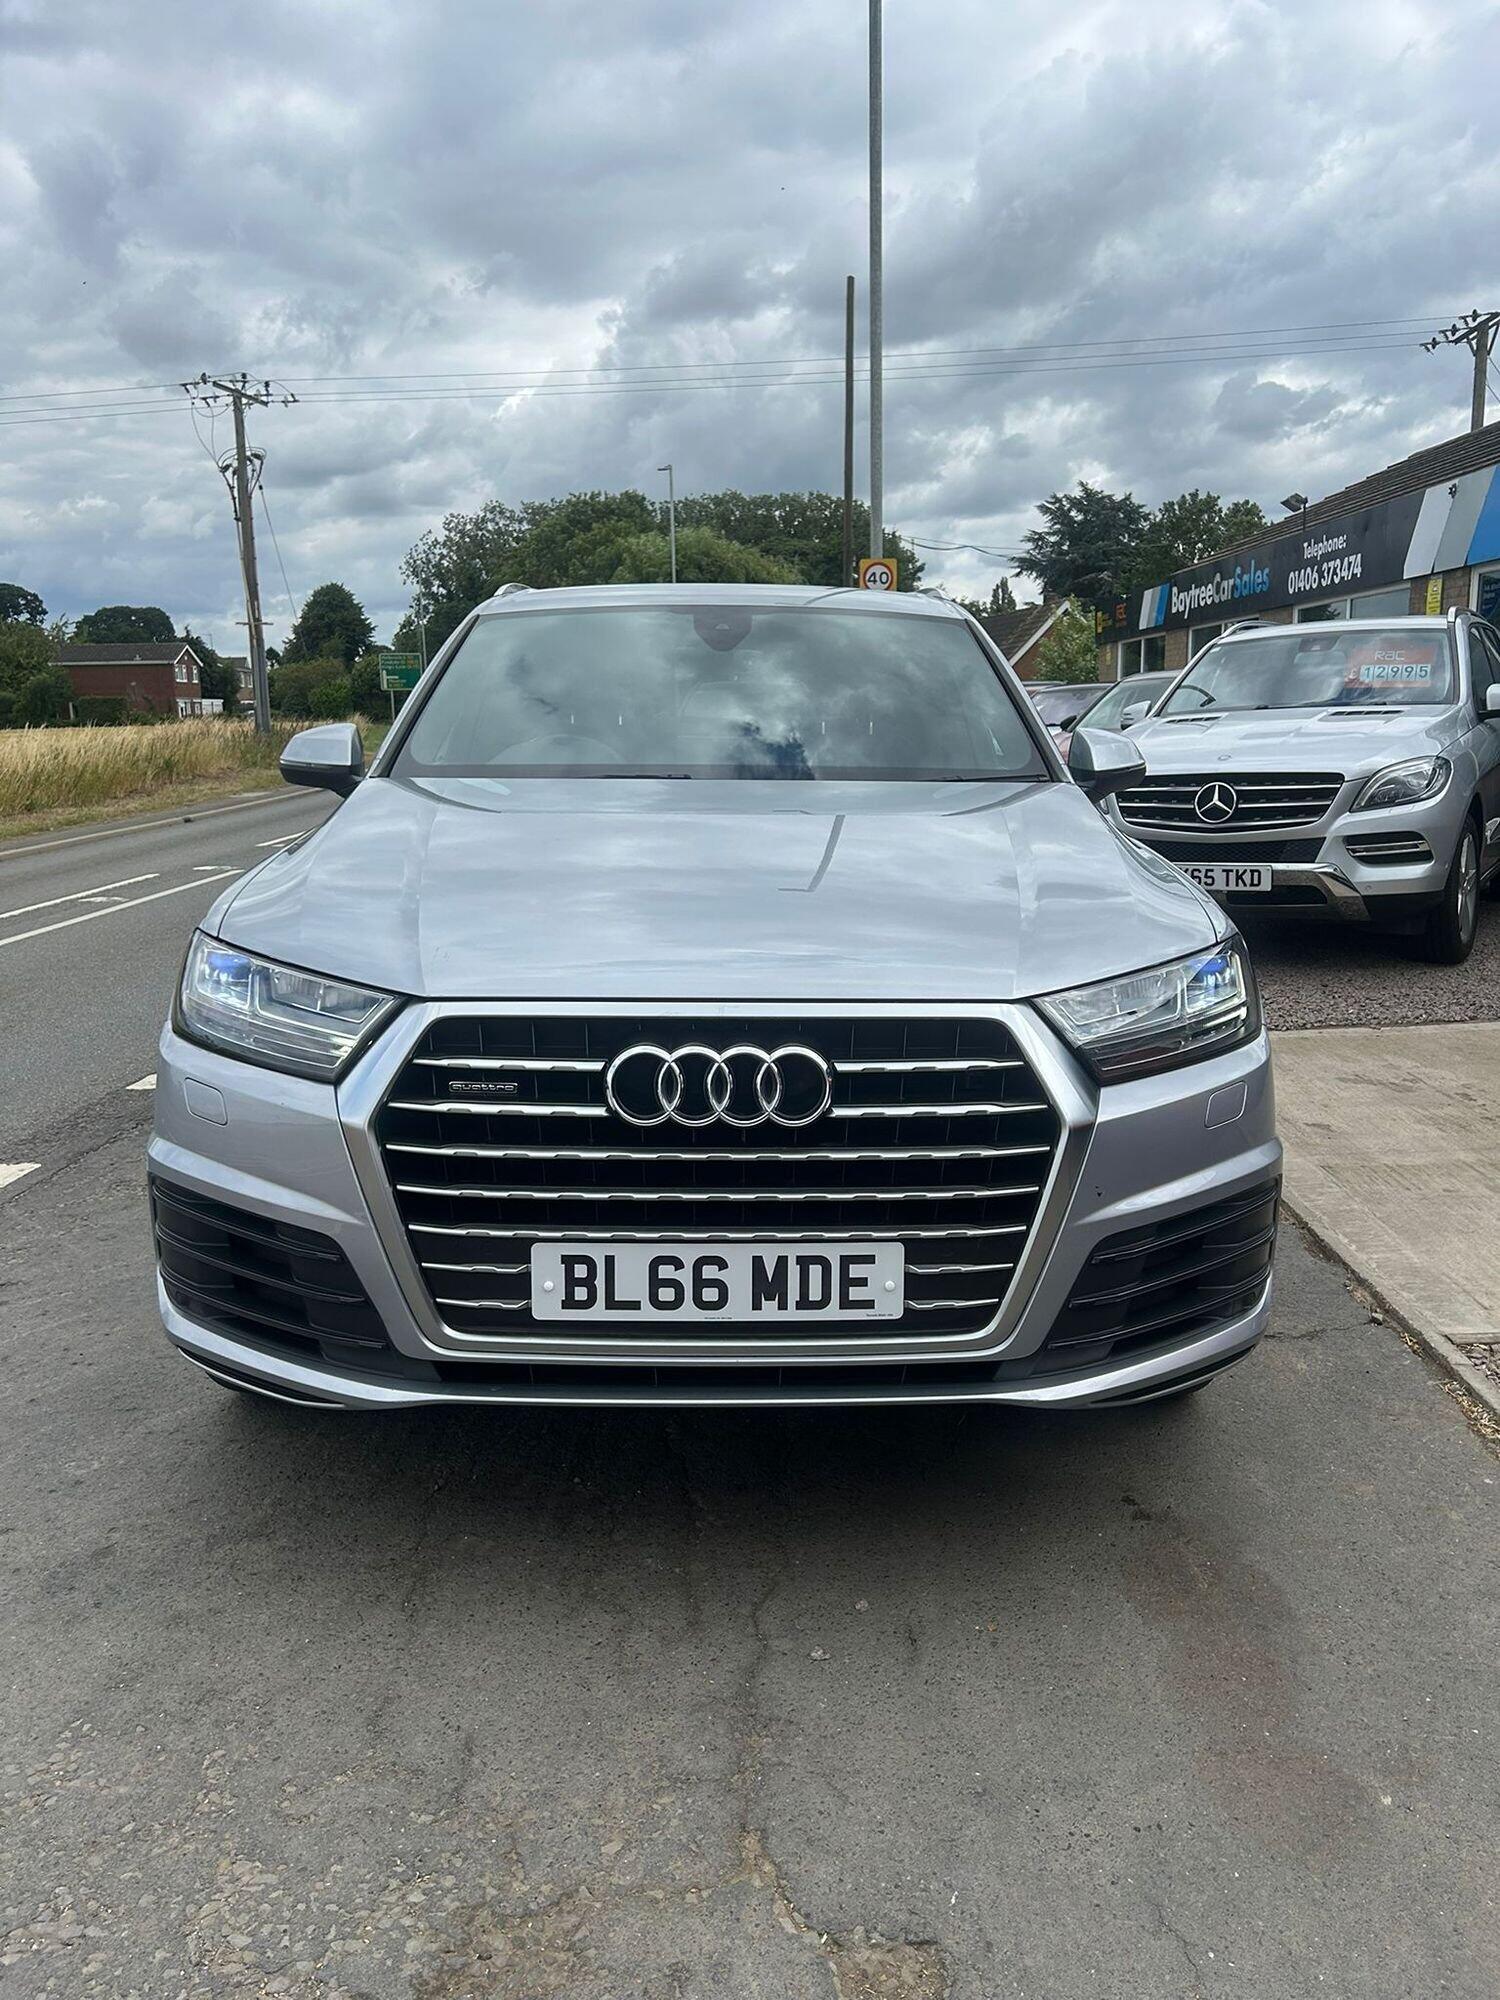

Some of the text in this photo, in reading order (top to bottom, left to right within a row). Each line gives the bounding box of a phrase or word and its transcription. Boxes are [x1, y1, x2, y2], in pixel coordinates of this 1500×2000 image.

[1302, 533, 1347, 560] Telephone:
[867, 571, 889, 585] 40
[1288, 553, 1362, 595] 01406 373474
[1221, 868, 1262, 887] TKD
[452, 1083, 514, 1093] quattro
[560, 1254, 876, 1311] BL66 MDE
